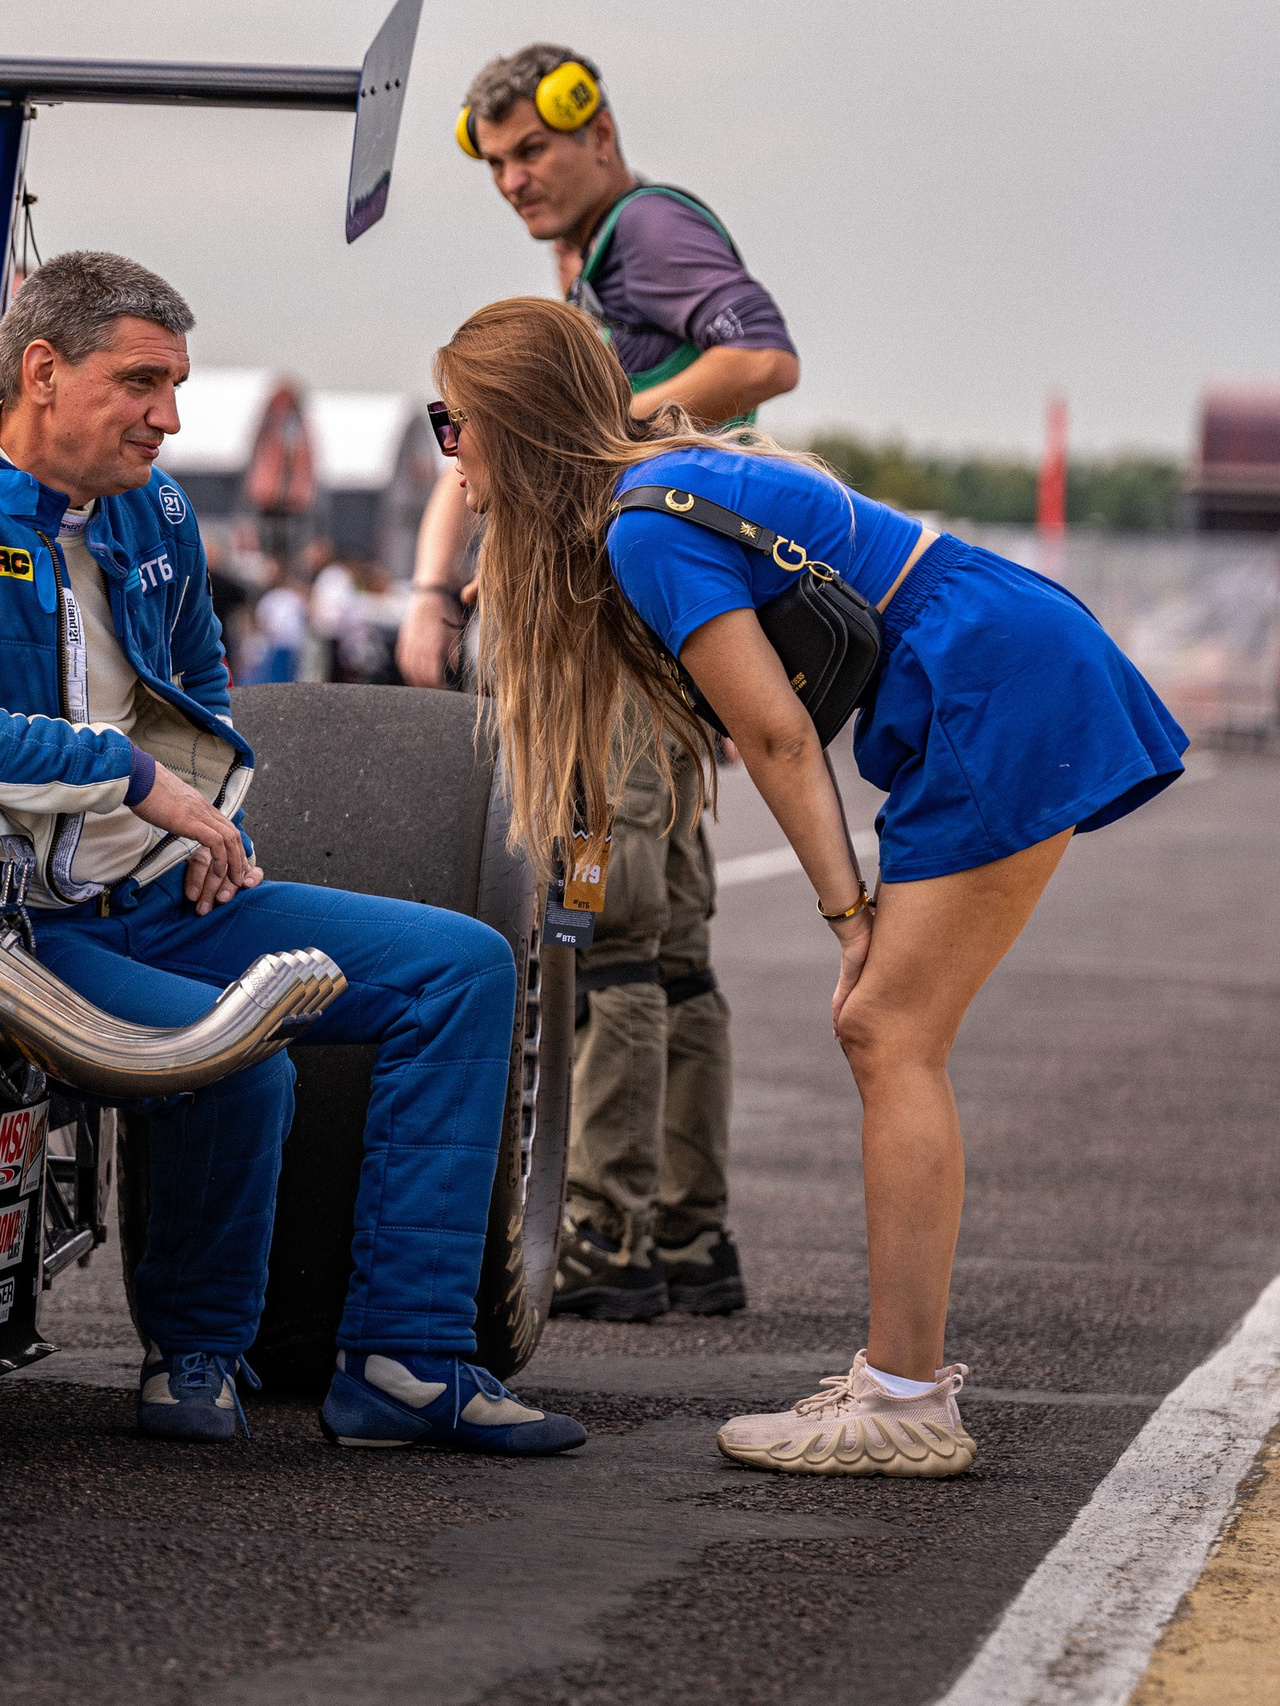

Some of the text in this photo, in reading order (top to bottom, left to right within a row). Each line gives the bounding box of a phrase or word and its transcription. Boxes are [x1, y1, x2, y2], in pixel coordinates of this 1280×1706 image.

[164, 496, 180, 511] 21
[66, 598, 79, 643] stand21
[562, 935, 576, 943] ВТБ
